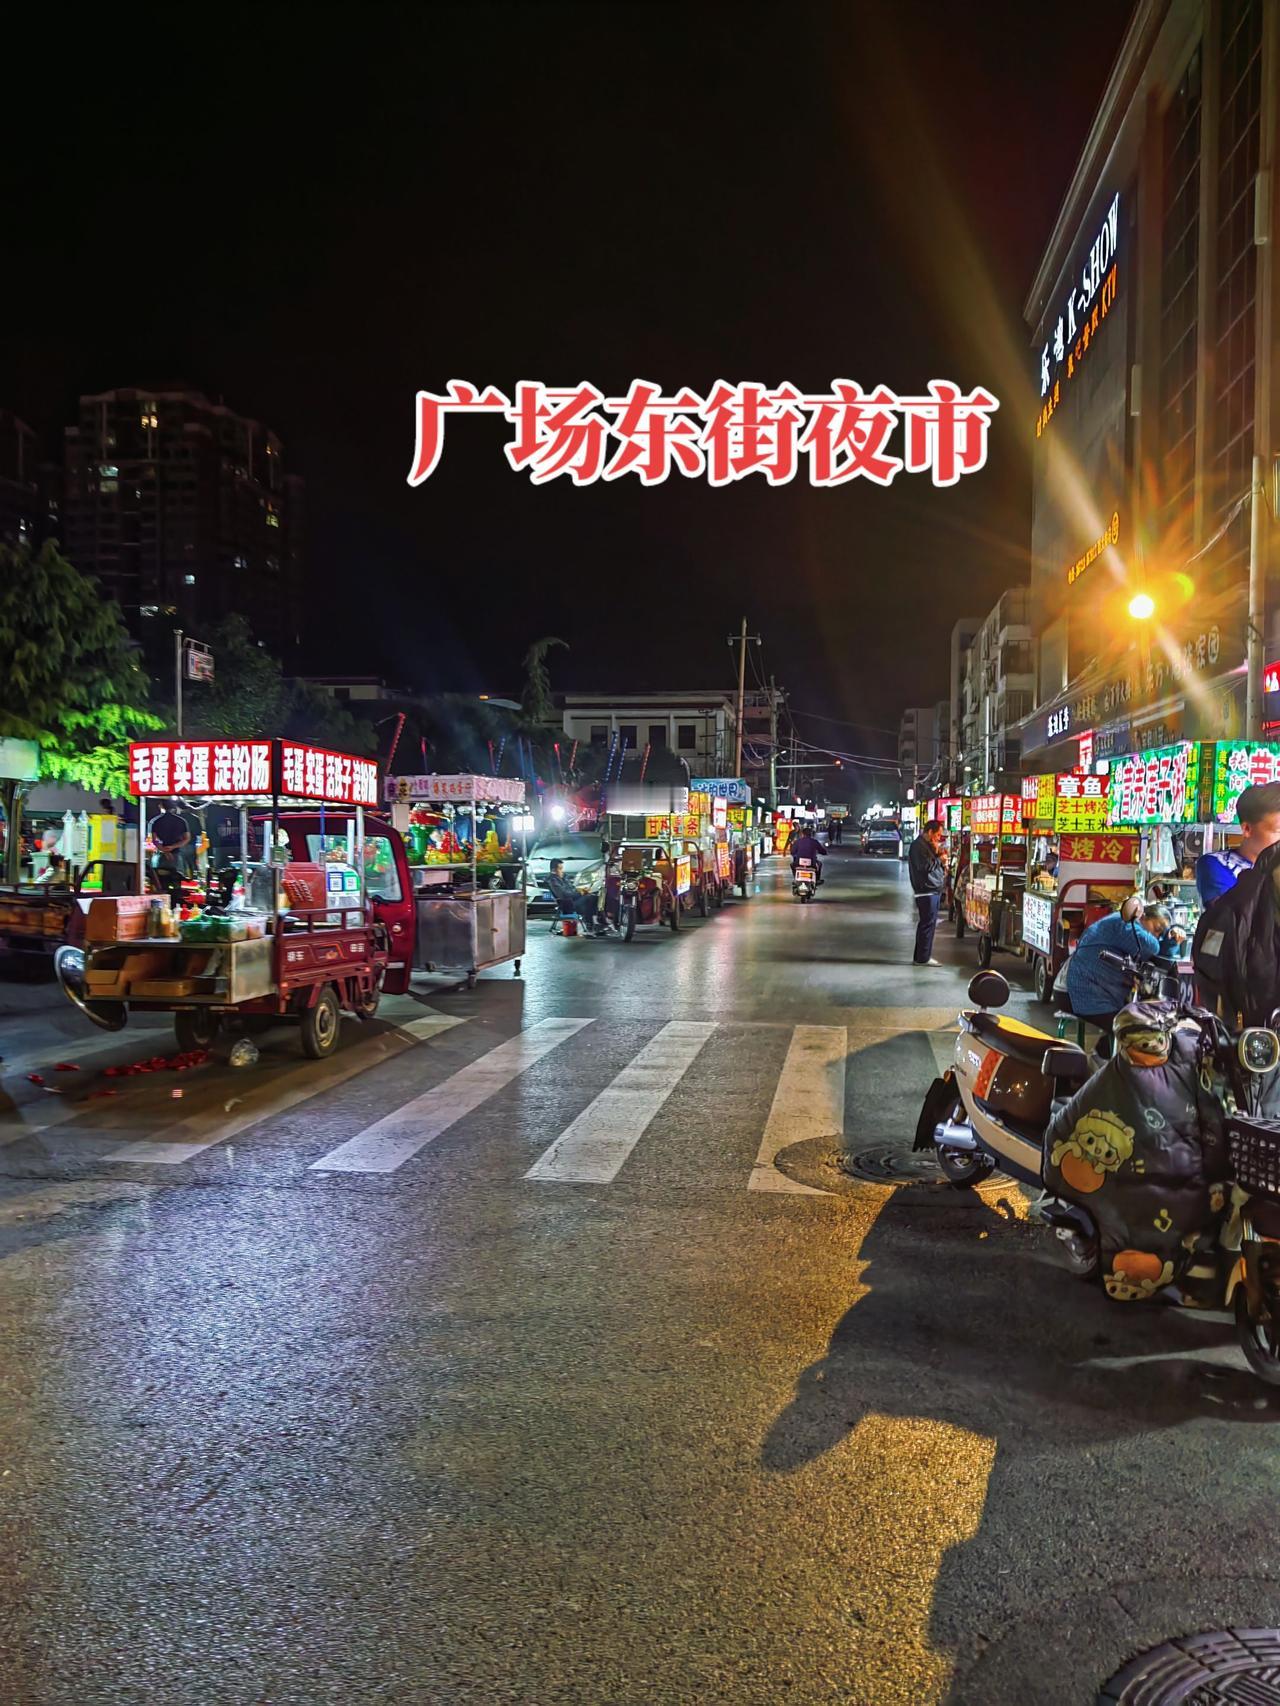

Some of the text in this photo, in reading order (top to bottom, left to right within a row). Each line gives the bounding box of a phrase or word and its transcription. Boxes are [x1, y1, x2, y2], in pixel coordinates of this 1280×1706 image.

[133, 744, 270, 792] 毛蛋 实蛋 淀粉肠
[283, 748, 304, 793] 毛蛋
[1058, 775, 1110, 798] 章鱼
[1201, 748, 1212, 815] 三十年老
